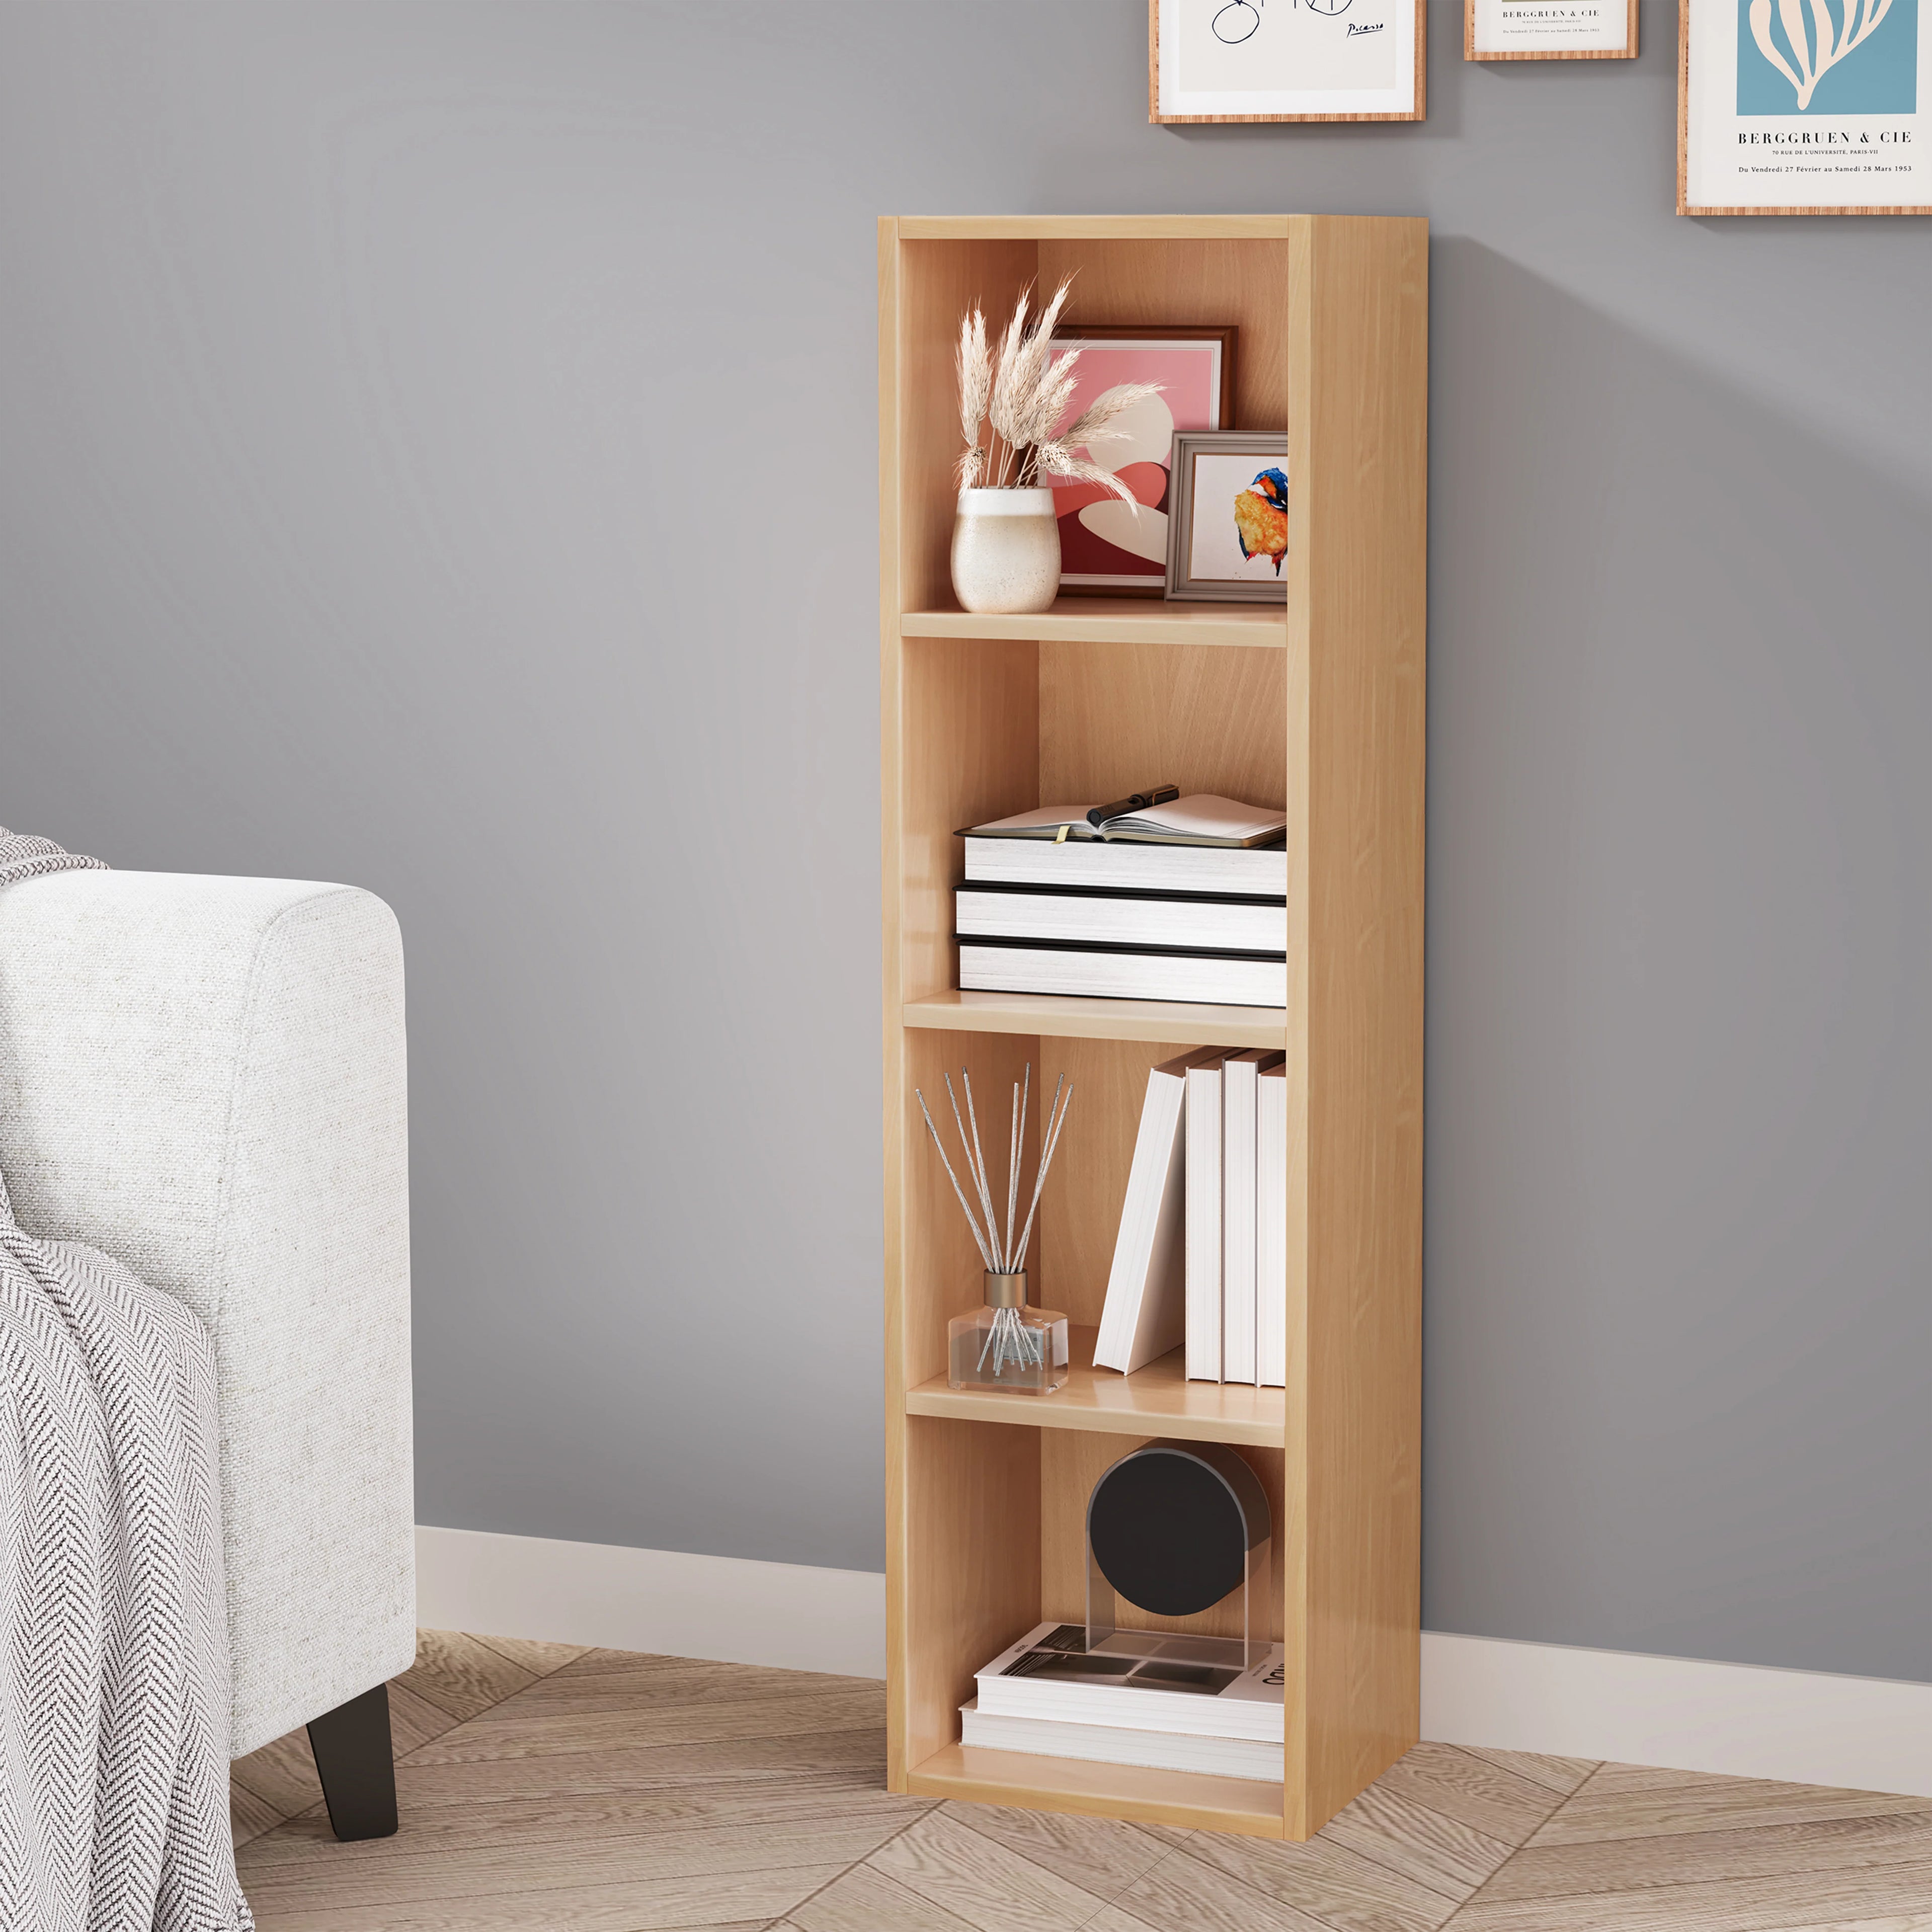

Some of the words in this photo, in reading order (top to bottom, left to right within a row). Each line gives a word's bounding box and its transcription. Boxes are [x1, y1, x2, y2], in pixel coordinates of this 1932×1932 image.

[1739, 132, 1849, 144] BERGGRUEN
[1860, 132, 1870, 143] &
[1880, 131, 1911, 143] CIE
